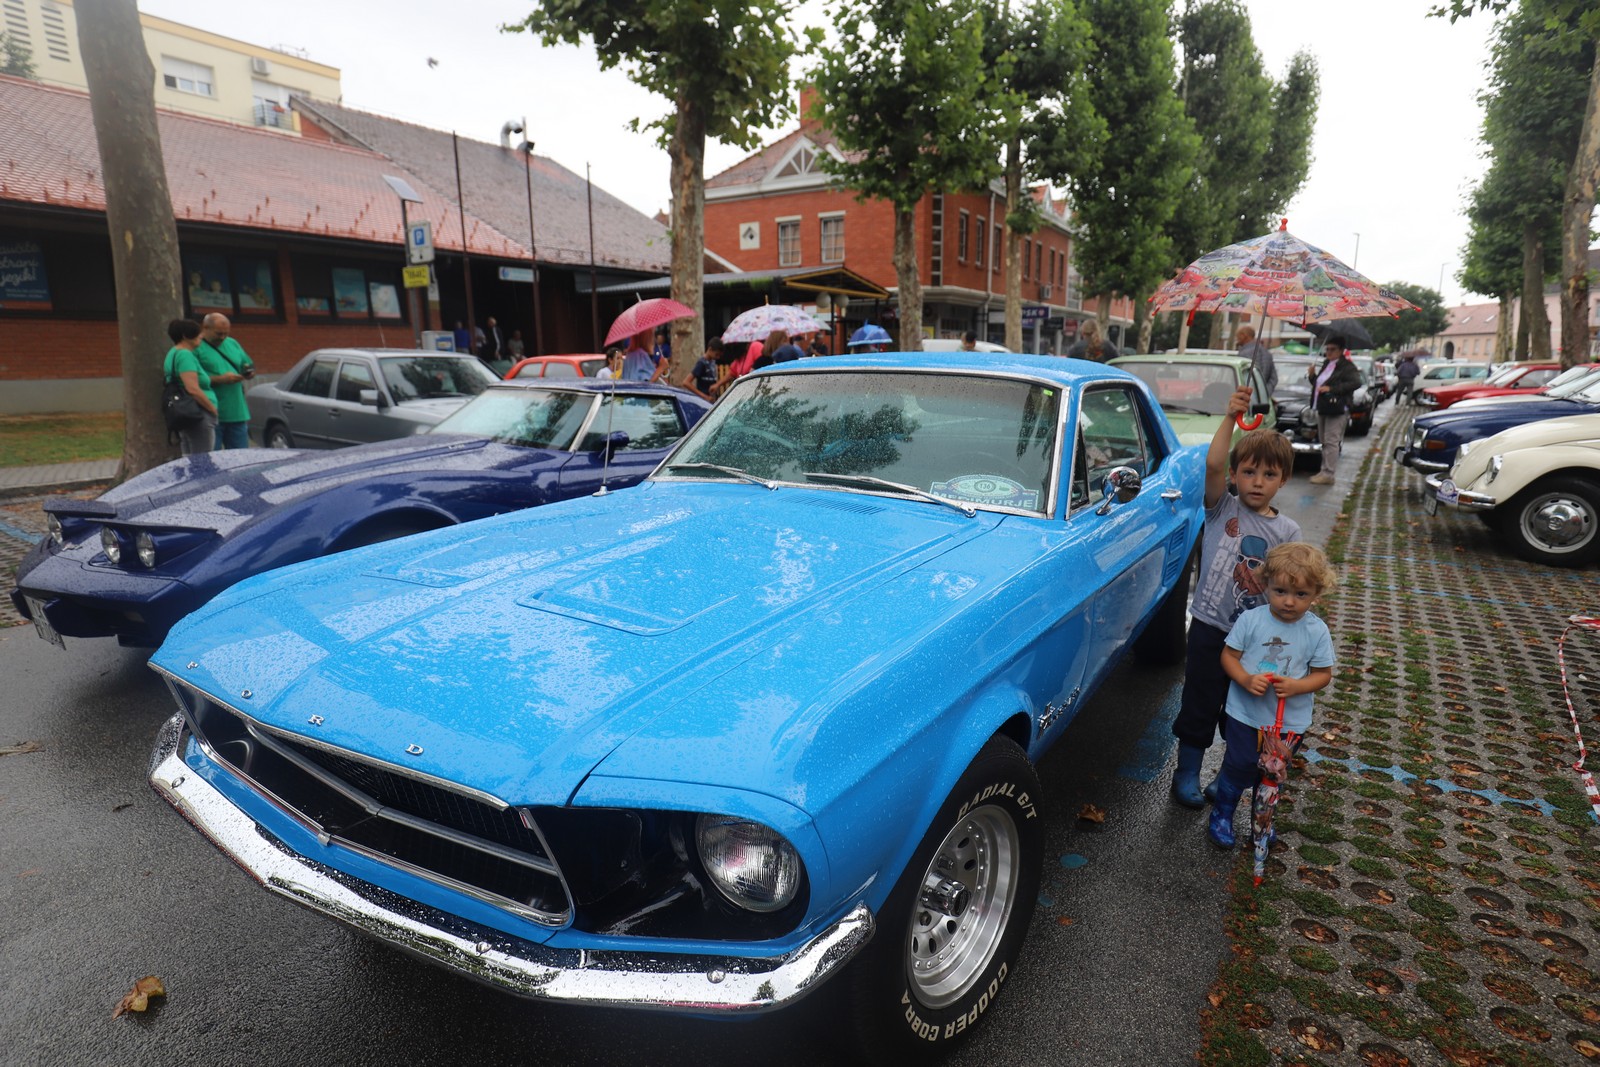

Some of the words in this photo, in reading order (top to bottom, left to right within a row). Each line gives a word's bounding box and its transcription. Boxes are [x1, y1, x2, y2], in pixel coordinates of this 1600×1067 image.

[415, 230, 423, 244] P
[979, 482, 991, 490] 136
[957, 782, 1016, 823] RADIAL
[1016, 792, 1037, 819] G/T
[901, 988, 940, 1041] COBRA
[944, 962, 1008, 1040] COOPER
